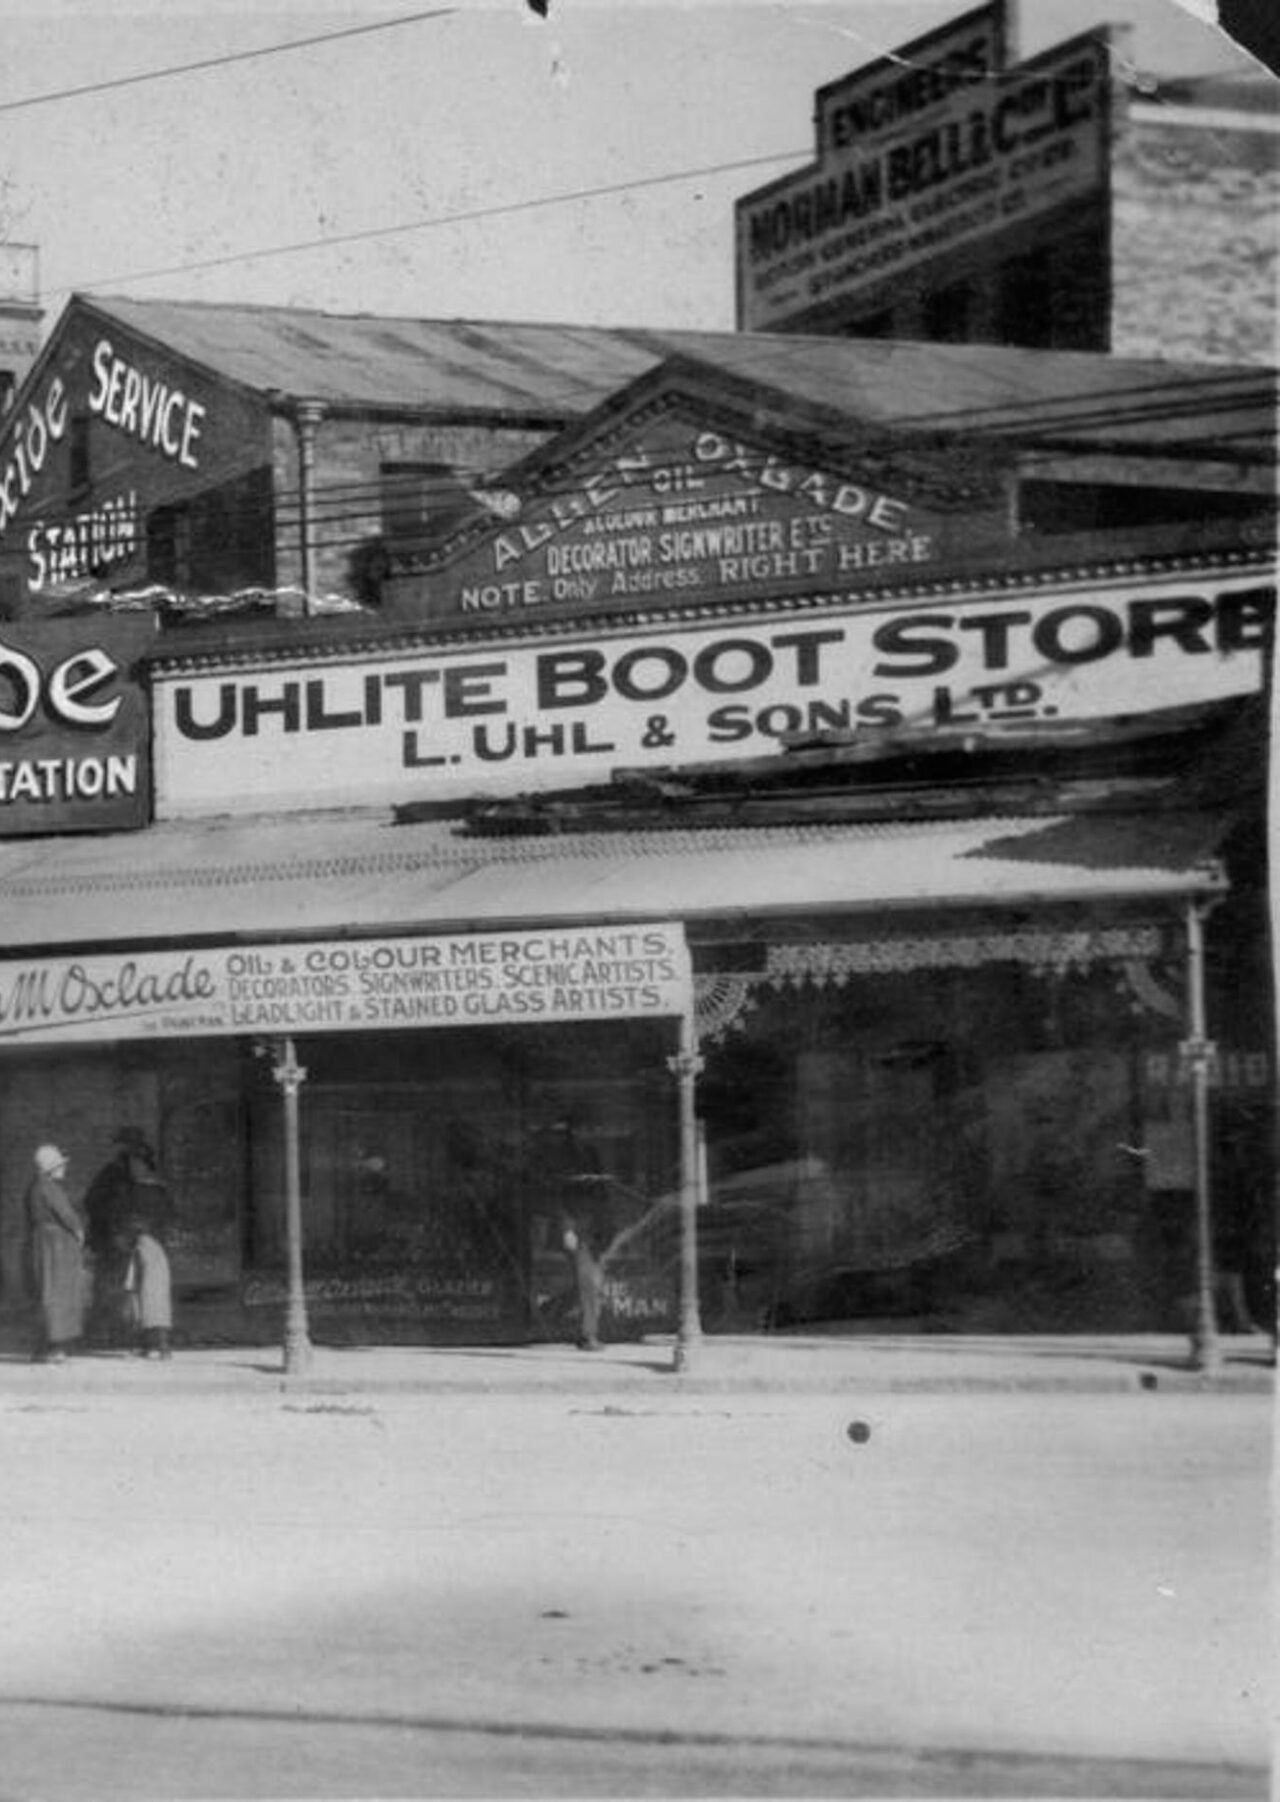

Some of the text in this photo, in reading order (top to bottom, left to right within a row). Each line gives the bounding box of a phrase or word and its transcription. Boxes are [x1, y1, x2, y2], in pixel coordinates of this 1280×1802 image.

[750, 158, 882, 264] NORMAN
[89, 340, 205, 468] SERVICE
[653, 465, 705, 492] OIL
[28, 490, 136, 592] STATION
[547, 536, 652, 576] DECORATOR
[659, 522, 784, 562] SIGNWRITER
[553, 577, 598, 599] Only
[720, 549, 823, 584] RIGHT
[838, 536, 932, 570] HERE
[174, 586, 1274, 741] UHLITE BOOT STORE
[641, 714, 675, 749] &
[706, 694, 904, 742] SONS
[60, 956, 217, 1019] Oxlade
[227, 953, 272, 976] OIL
[281, 958, 296, 975] &
[305, 945, 441, 972] COLOUR
[503, 962, 578, 990] SCENIC
[231, 1000, 343, 1026] LEADLIGHT
[350, 1005, 362, 1022] &
[366, 995, 458, 1021] STAINED
[464, 990, 547, 1016] GLASS
